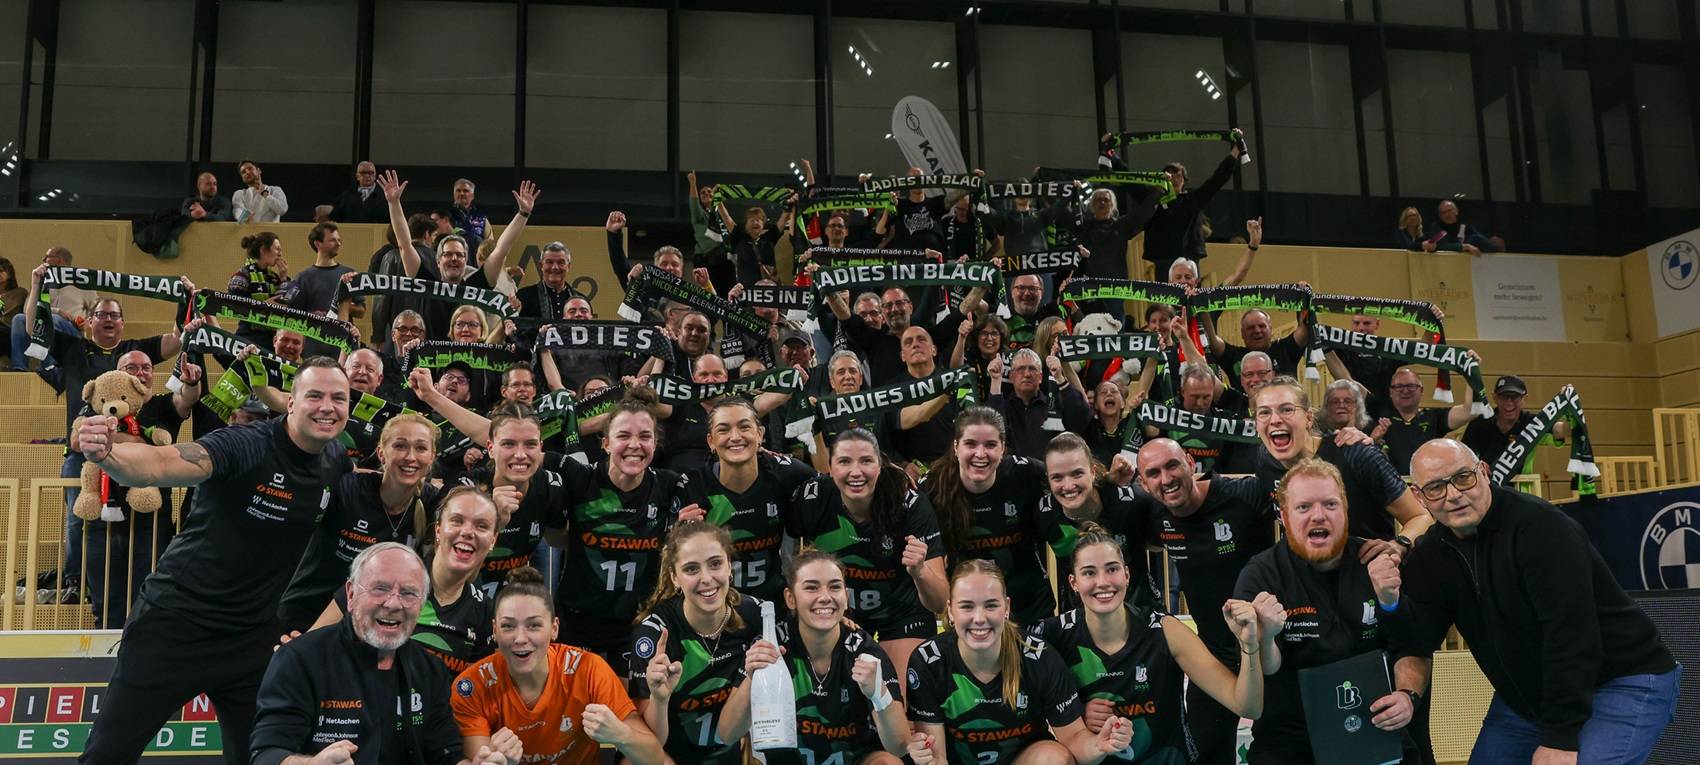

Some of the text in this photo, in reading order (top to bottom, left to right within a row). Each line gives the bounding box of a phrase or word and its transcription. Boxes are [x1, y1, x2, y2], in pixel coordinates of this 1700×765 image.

[864, 175, 916, 193] LADIES
[920, 175, 938, 184] IN
[989, 183, 1073, 198] LADIES
[96, 270, 122, 288] IN
[817, 262, 997, 288] ADIES IN BLACK
[345, 274, 518, 318] LADIES IN BLAC
[779, 291, 797, 303] IN
[307, 311, 330, 323] made
[545, 325, 653, 350] ADIES
[1057, 335, 1161, 357] ES IN BL
[1316, 323, 1479, 376] ADIES IN BLACK
[699, 384, 725, 399] IN
[820, 387, 905, 420] LADIES
[909, 378, 936, 399] IN
[1211, 417, 1238, 435] IN
[1242, 419, 1260, 438] B
[1520, 416, 1545, 443] IN
[265, 487, 294, 501] STAWAG
[348, 532, 377, 544] STAWAG
[600, 537, 659, 550] STAWAG
[600, 560, 637, 592] 11
[733, 559, 766, 588] 15
[846, 588, 882, 611] 18
[326, 699, 363, 709] STAWAG
[325, 717, 360, 725] NetAachen
[801, 719, 856, 739] STAWAG
[968, 723, 1032, 743] STAWAG
